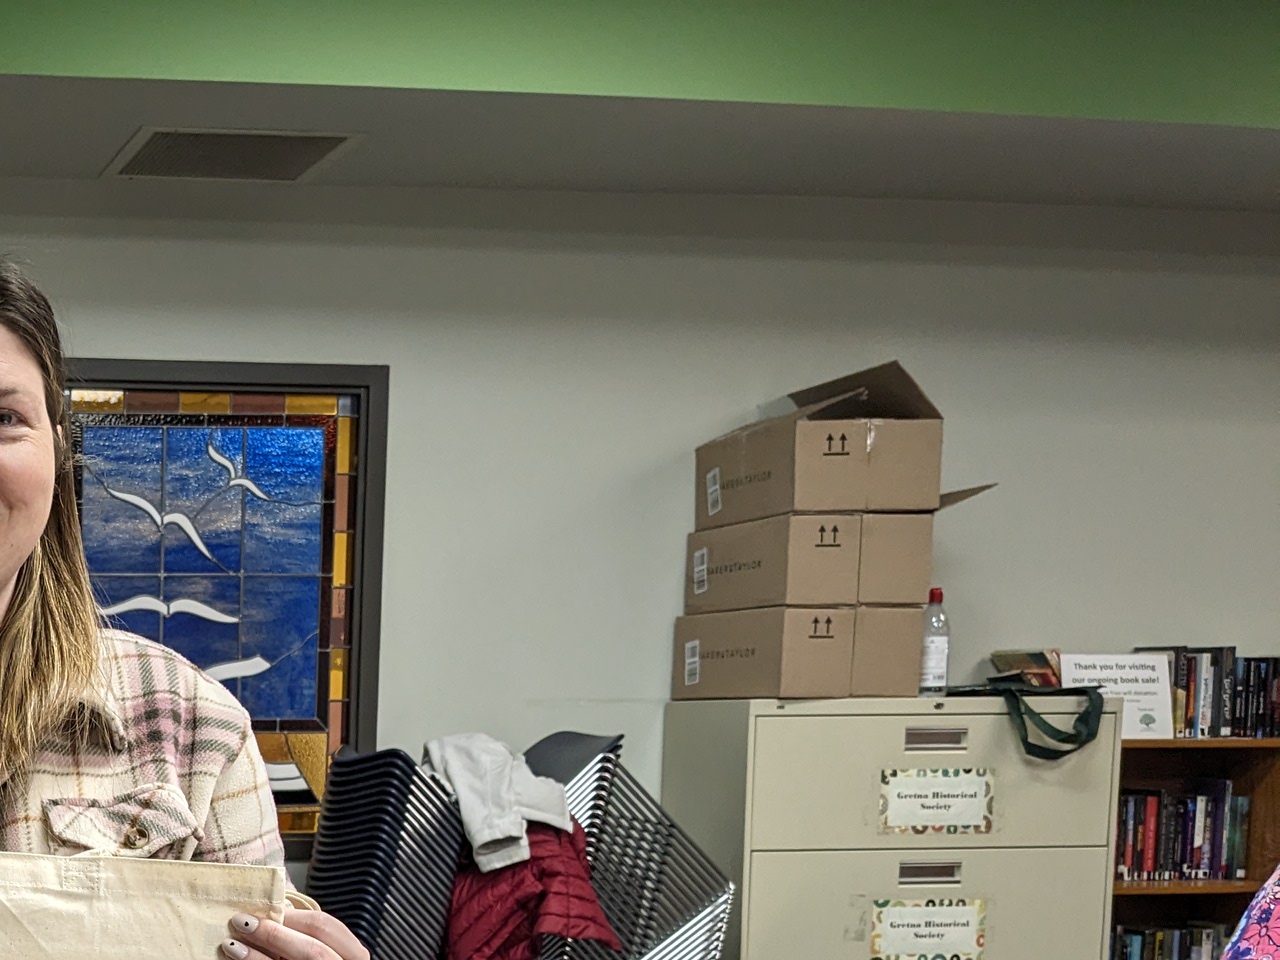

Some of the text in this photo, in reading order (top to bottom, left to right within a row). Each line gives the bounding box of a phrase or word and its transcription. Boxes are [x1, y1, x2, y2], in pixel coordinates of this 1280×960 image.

[1099, 664, 1113, 672] you
[1128, 663, 1156, 672] visiting
[1088, 677, 1118, 685] ongoing
[1120, 676, 1140, 684] book
[1141, 676, 1159, 684] sale!
[897, 791, 977, 800] Gretna Historical
[920, 803, 952, 811] Society
[889, 920, 969, 929] Gretna Historical
[913, 932, 945, 940] Society
